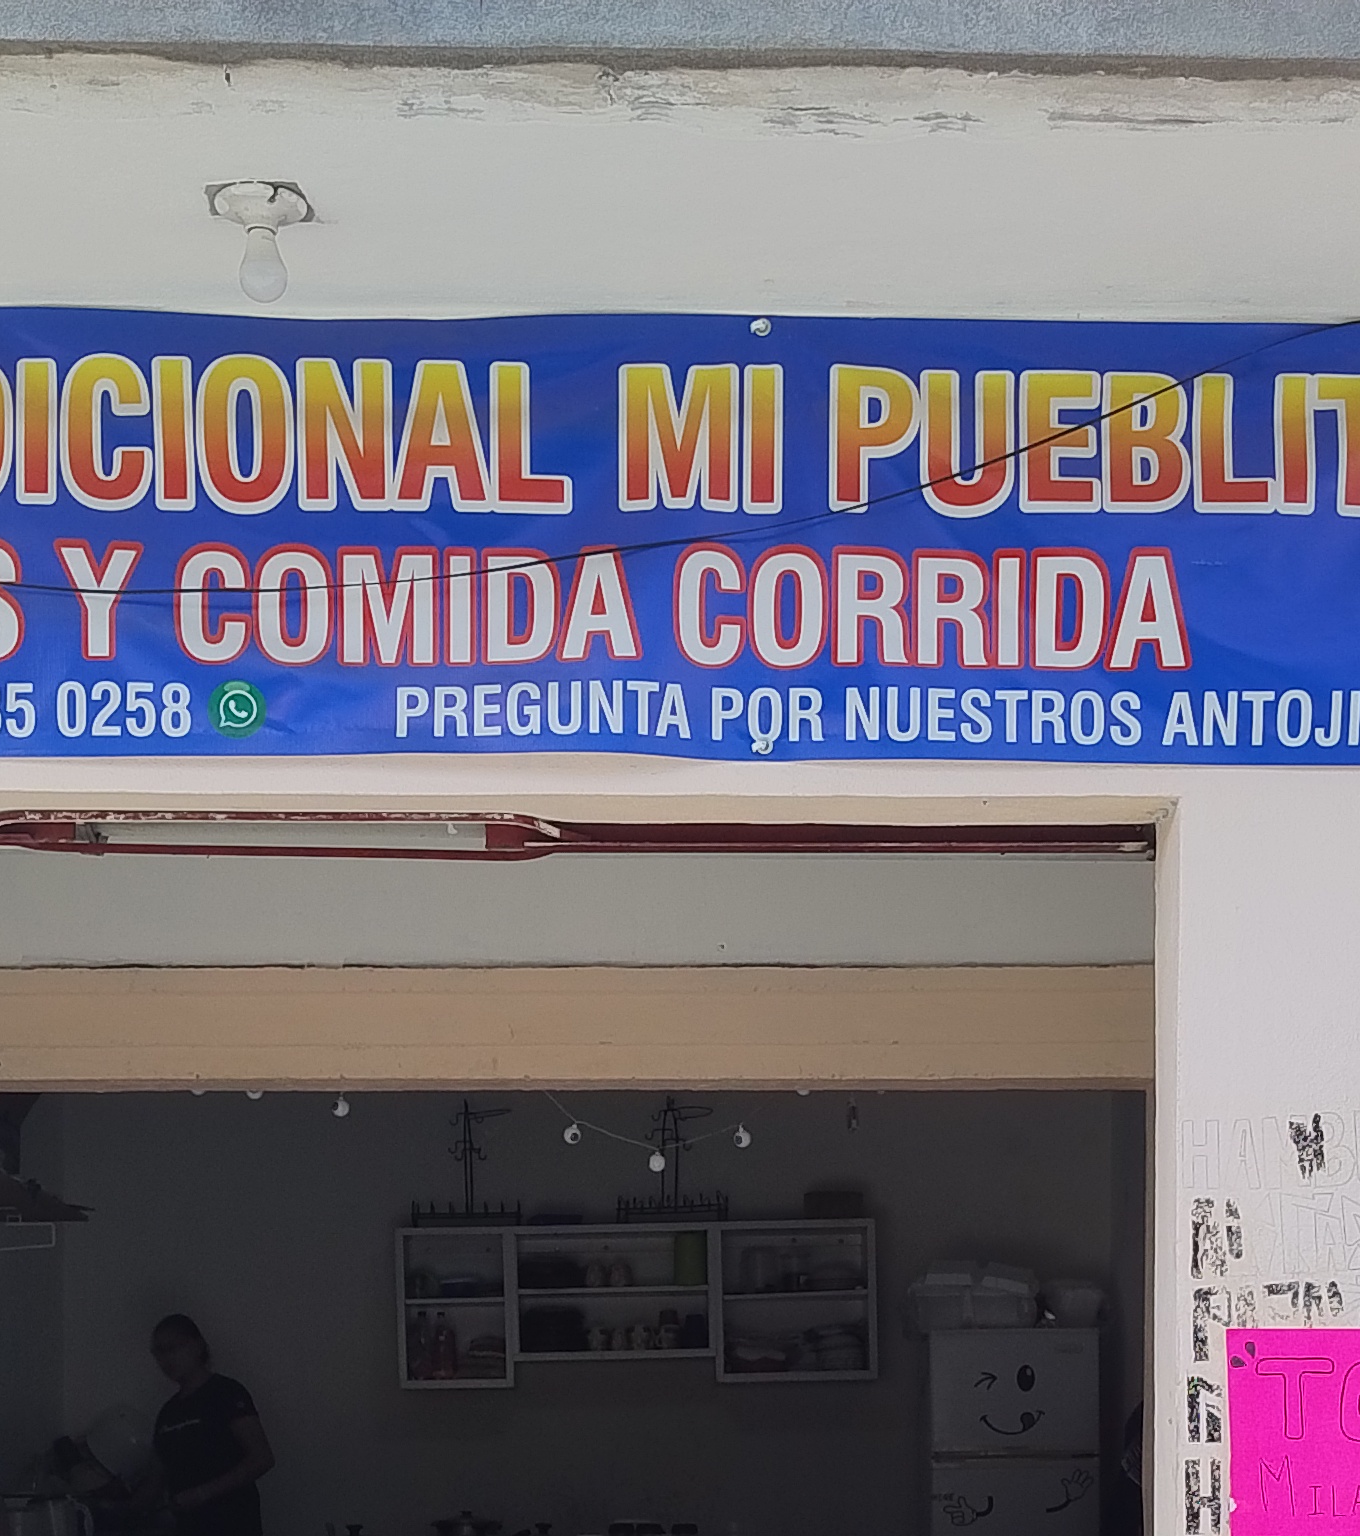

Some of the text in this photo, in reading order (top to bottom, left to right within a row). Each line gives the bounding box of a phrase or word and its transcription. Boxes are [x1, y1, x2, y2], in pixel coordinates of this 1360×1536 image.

[617, 361, 785, 515] MI
[54, 539, 146, 661] Y
[173, 541, 644, 668] COMIDA
[671, 544, 1193, 673] CORRIDA
[54, 680, 193, 739] 0258
[394, 682, 688, 743] PREGUNTA
[709, 688, 822, 746] POR
[845, 686, 1140, 747] NUESTROS
